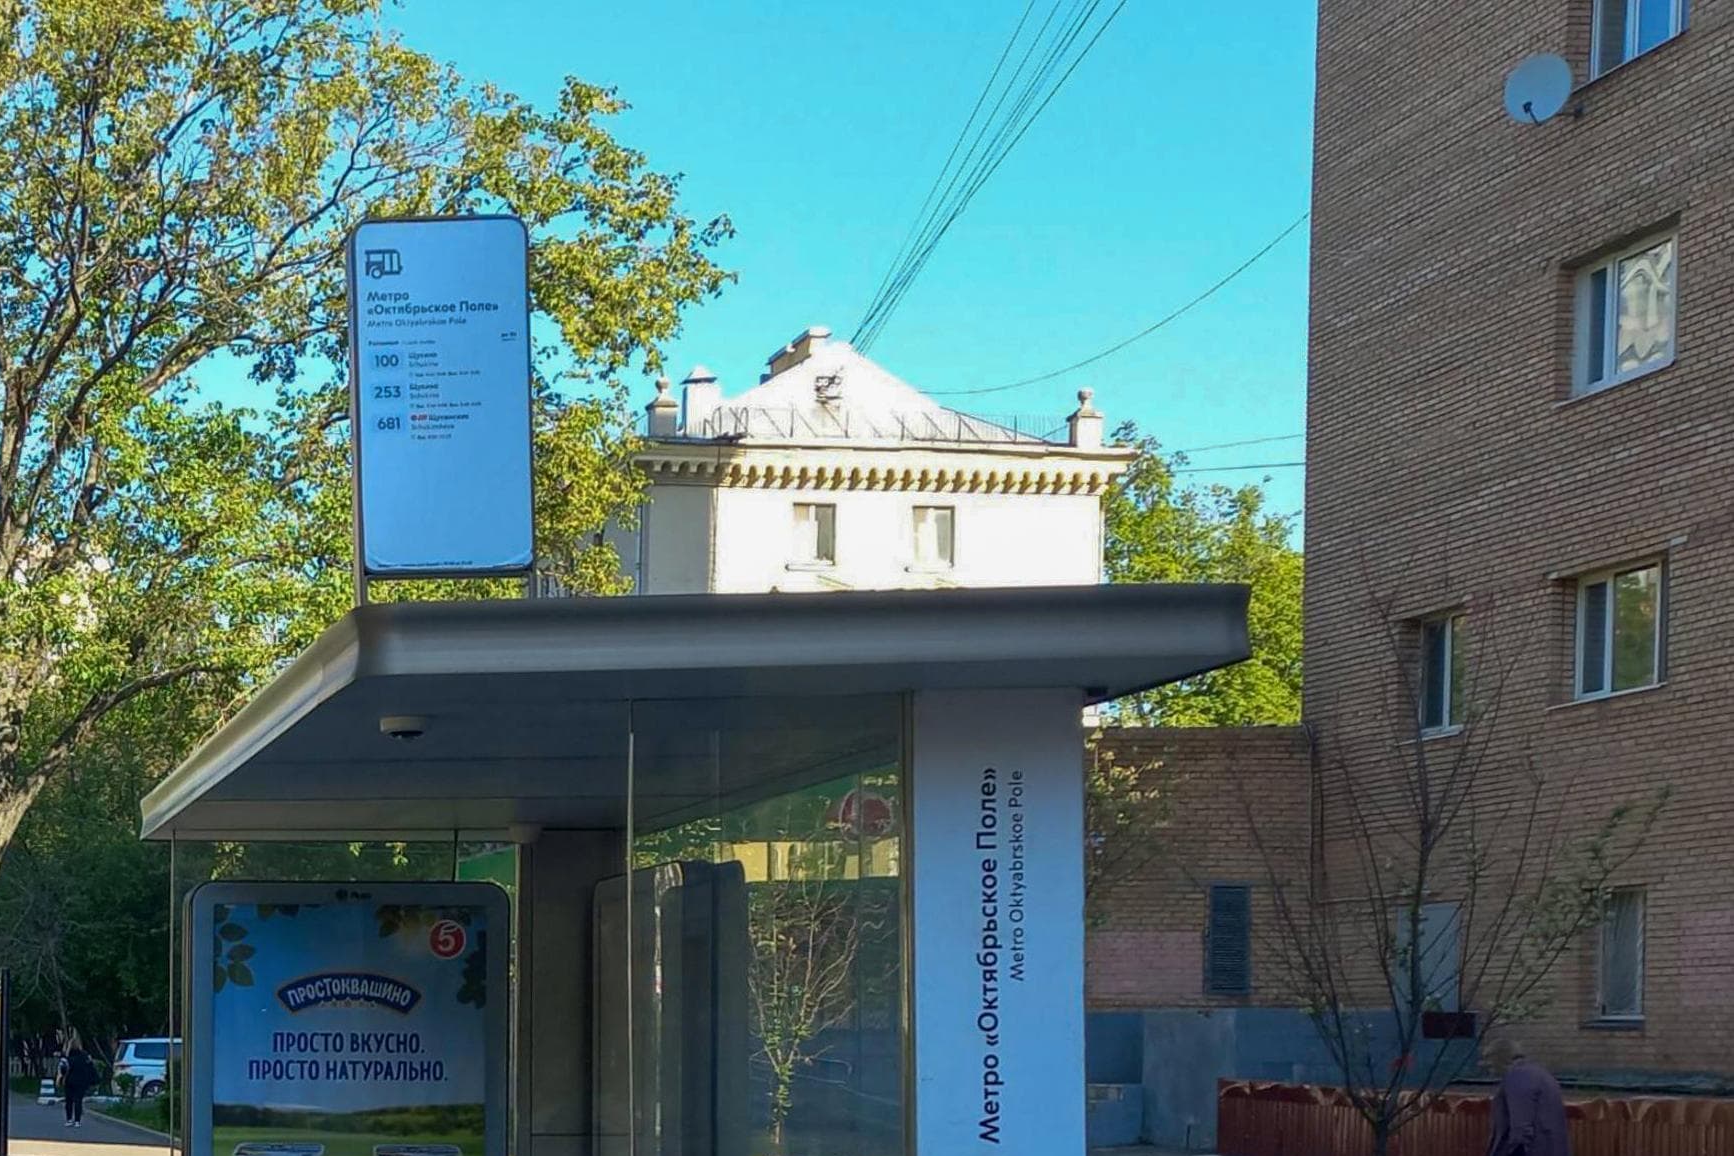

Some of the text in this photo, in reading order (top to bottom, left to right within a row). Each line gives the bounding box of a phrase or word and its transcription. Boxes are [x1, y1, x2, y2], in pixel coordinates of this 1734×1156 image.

[367, 291, 410, 304] Метро
[367, 300, 499, 316] «Октябрьское Поле»
[374, 354, 399, 367] 100
[374, 385, 402, 399] 253
[377, 416, 401, 430] 681
[1007, 769, 1027, 982] Metro Oktyabrskoe Pole
[976, 767, 1005, 1144] Метро «Октябрьское Поле»
[286, 977, 412, 1007] ПРОСТОКВАШИНО
[272, 1031, 425, 1054] ПРОСТО ВКУСНО.
[248, 1060, 448, 1081] ПРОСТО НАТУРАЛЬНО.
